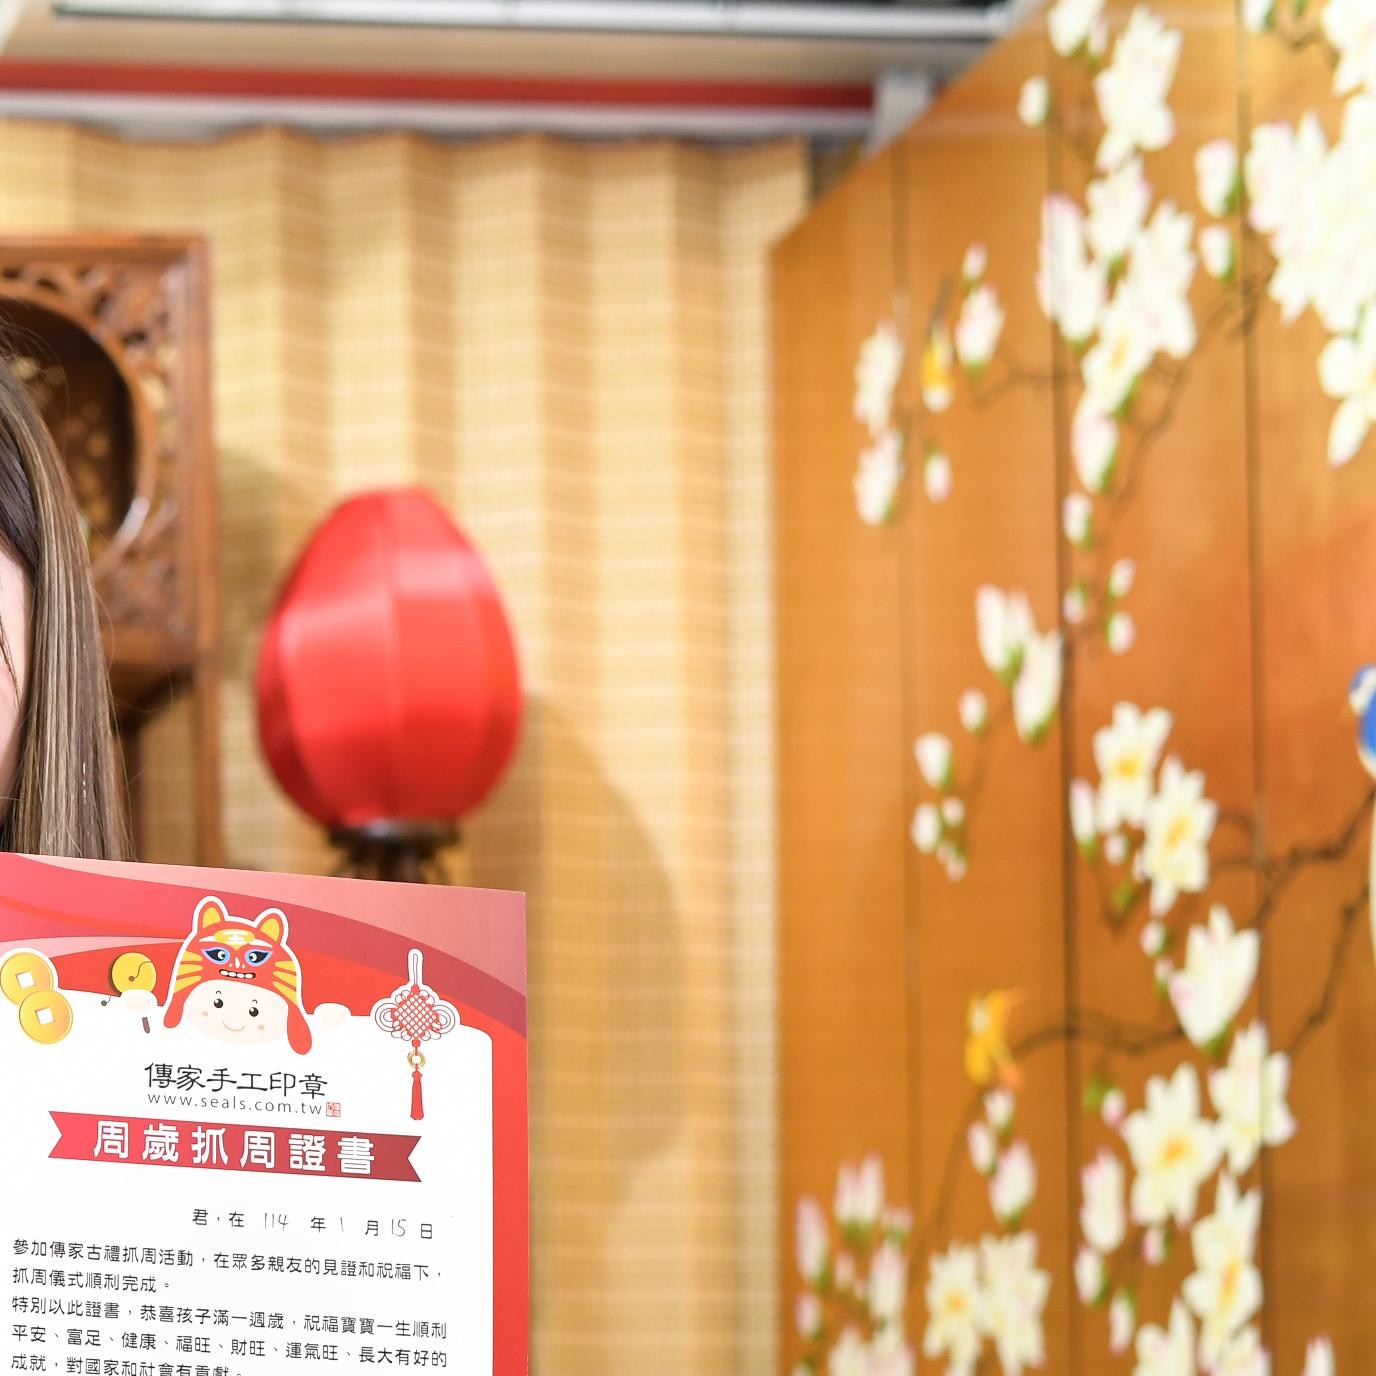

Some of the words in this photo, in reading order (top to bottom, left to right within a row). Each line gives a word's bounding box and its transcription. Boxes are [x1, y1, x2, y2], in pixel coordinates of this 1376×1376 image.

[145, 1063, 327, 1099] 傳家手工印章
[148, 1095, 321, 1114] www.seals.com.tw
[94, 1121, 374, 1174] 周歲抓周證書
